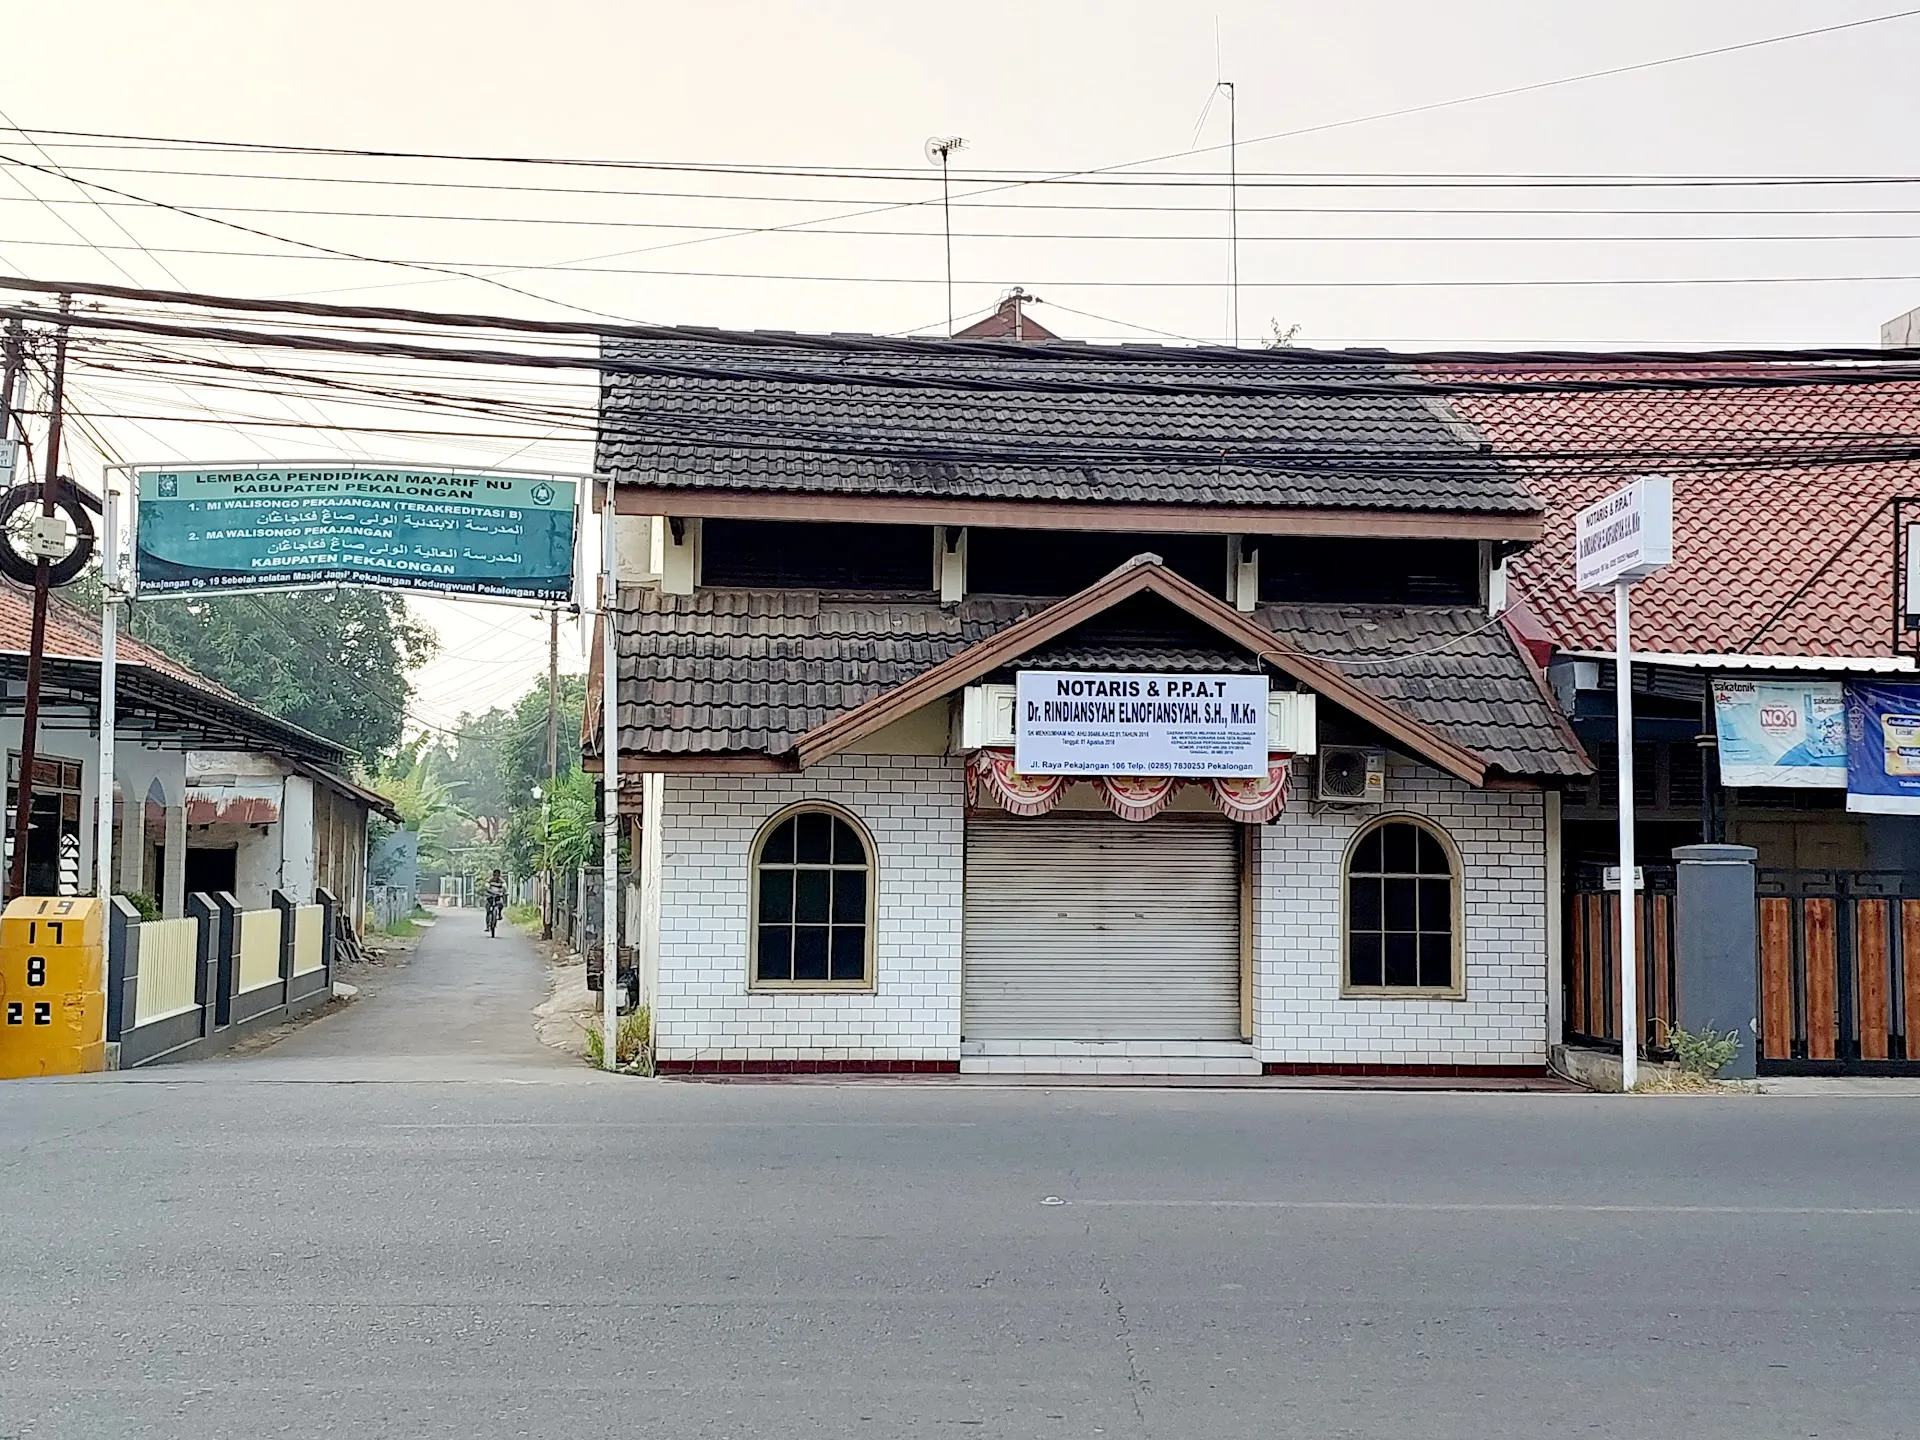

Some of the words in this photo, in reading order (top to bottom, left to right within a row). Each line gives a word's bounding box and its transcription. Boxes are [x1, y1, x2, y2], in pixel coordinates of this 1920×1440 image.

[196, 472, 281, 484] LEMBAGA
[287, 472, 399, 482] PENDIDIKAN
[405, 475, 479, 487] MA'ARIF
[486, 480, 512, 490] NU
[234, 484, 339, 494] KABUPATEN
[345, 483, 473, 499] PEKALONGAN
[188, 502, 200, 512] 1.
[207, 501, 222, 511] MI
[223, 499, 300, 510] WALISONGO
[302, 498, 391, 510] PEKAJANGAN
[394, 501, 506, 519] (TERAKREDITASI
[508, 511, 523, 522] B)
[1585, 505, 1609, 529] NOTARIS
[188, 532, 199, 541] 2.
[206, 531, 224, 540] MA
[225, 528, 302, 539] WALISONGO
[304, 526, 393, 539] PEKAJANGAN
[251, 553, 338, 568] KABUPATEN
[342, 554, 455, 574] PEKALONGAN
[139, 579, 190, 592] Pekajangan
[192, 578, 206, 589] Gg.
[209, 576, 220, 586] 19
[221, 574, 257, 586] Sebelah
[258, 573, 292, 583] selatan
[292, 570, 322, 583] Masjid
[352, 572, 412, 588] Pekajangan
[413, 577, 476, 593] Kedungwuni
[477, 584, 536, 599] Pekalongan
[537, 589, 568, 600] 51172
[1056, 680, 1140, 697] NOTARIS
[1147, 681, 1160, 697] &
[1167, 681, 1227, 698] P.P.A.T
[1714, 682, 1756, 693] sakatonik
[1027, 701, 1041, 722] Dr.
[1044, 701, 1116, 723] RINDIANSYAH
[1204, 702, 1228, 729] S.H.,
[1230, 703, 1256, 724] M.Kn
[1760, 709, 1797, 728] NO.1
[1030, 761, 1040, 769] Jl.
[1042, 761, 1062, 770] Raya
[1064, 761, 1110, 771] Pekajangan
[1112, 762, 1126, 770] 106
[1127, 762, 1146, 771] Telp.
[1148, 762, 1172, 771] (0285)
[1207, 762, 1254, 772] Pekalongan
[37, 900, 75, 915] 19
[29, 922, 63, 945] 17
[27, 956, 46, 987] 8
